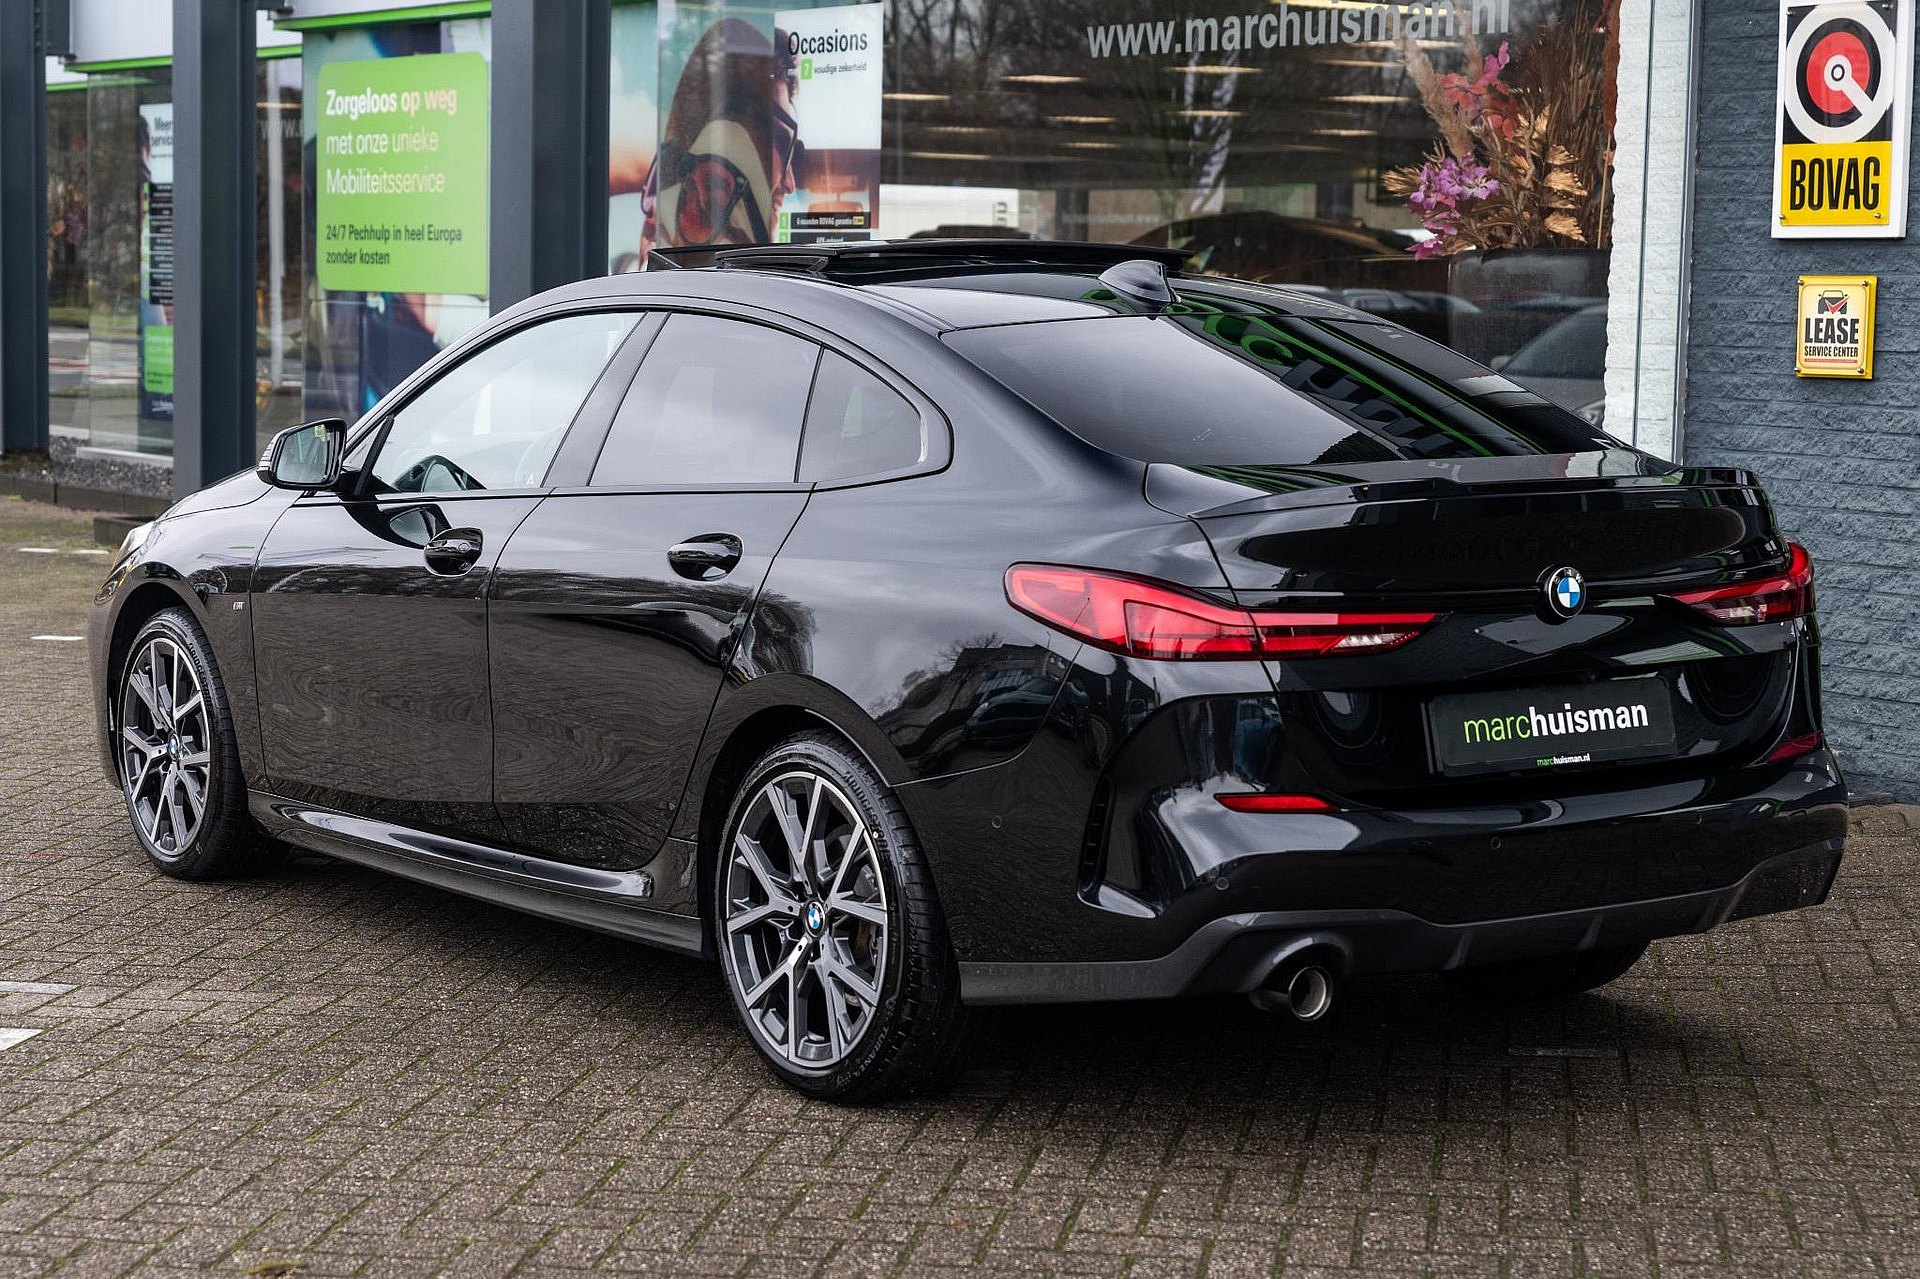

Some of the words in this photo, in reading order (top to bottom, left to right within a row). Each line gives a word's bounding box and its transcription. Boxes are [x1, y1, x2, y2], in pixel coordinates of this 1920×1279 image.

[788, 28, 868, 55] Occasions
[1087, 0, 1510, 58] www.marchuisman.nl
[326, 87, 397, 120] Zorgeloos
[401, 91, 420, 117] op
[424, 88, 458, 115] weg
[326, 132, 353, 155] met
[356, 134, 388, 154] onze
[392, 126, 438, 152] unieke
[326, 166, 445, 194] Mobiliteitsservice
[1790, 156, 1880, 211] BOVAG
[326, 223, 346, 240] 24/7
[348, 223, 390, 243] Pechhulp
[393, 224, 402, 240] in
[404, 224, 425, 241] heel
[428, 224, 462, 243] Europa
[326, 248, 357, 264] zonder
[359, 248, 390, 265] kosten
[1804, 317, 1859, 344] LEASE
[1804, 345, 1832, 357] SERVICE
[1833, 346, 1859, 357] CENTER
[1463, 703, 1649, 744] marchuisman
[1536, 753, 1590, 766] marchuisman.nl
